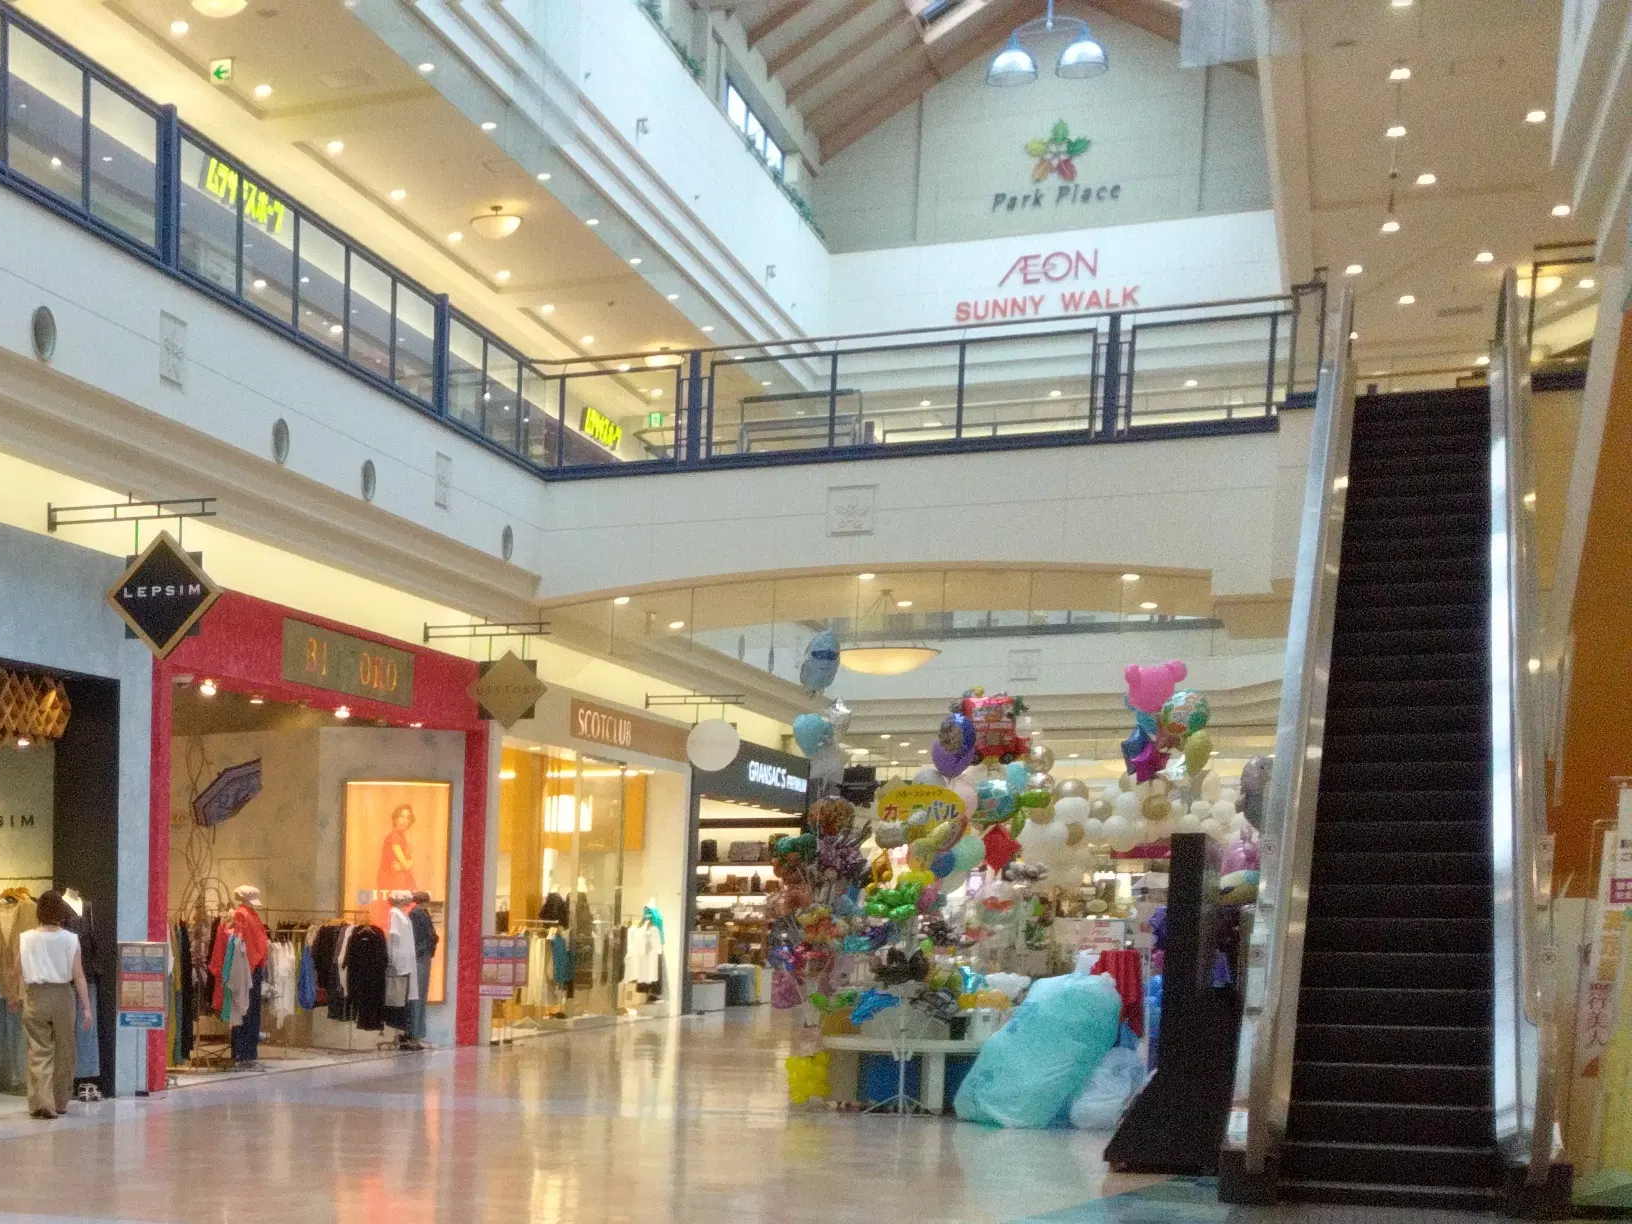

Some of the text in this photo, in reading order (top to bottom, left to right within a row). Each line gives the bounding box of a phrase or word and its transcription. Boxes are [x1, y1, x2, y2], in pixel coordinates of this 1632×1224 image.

[992, 184, 1121, 212] Park Place
[955, 285, 1140, 322] SUNNY WALK
[123, 584, 202, 599] LEPSIM
[578, 708, 632, 747] SCOTCLUB
